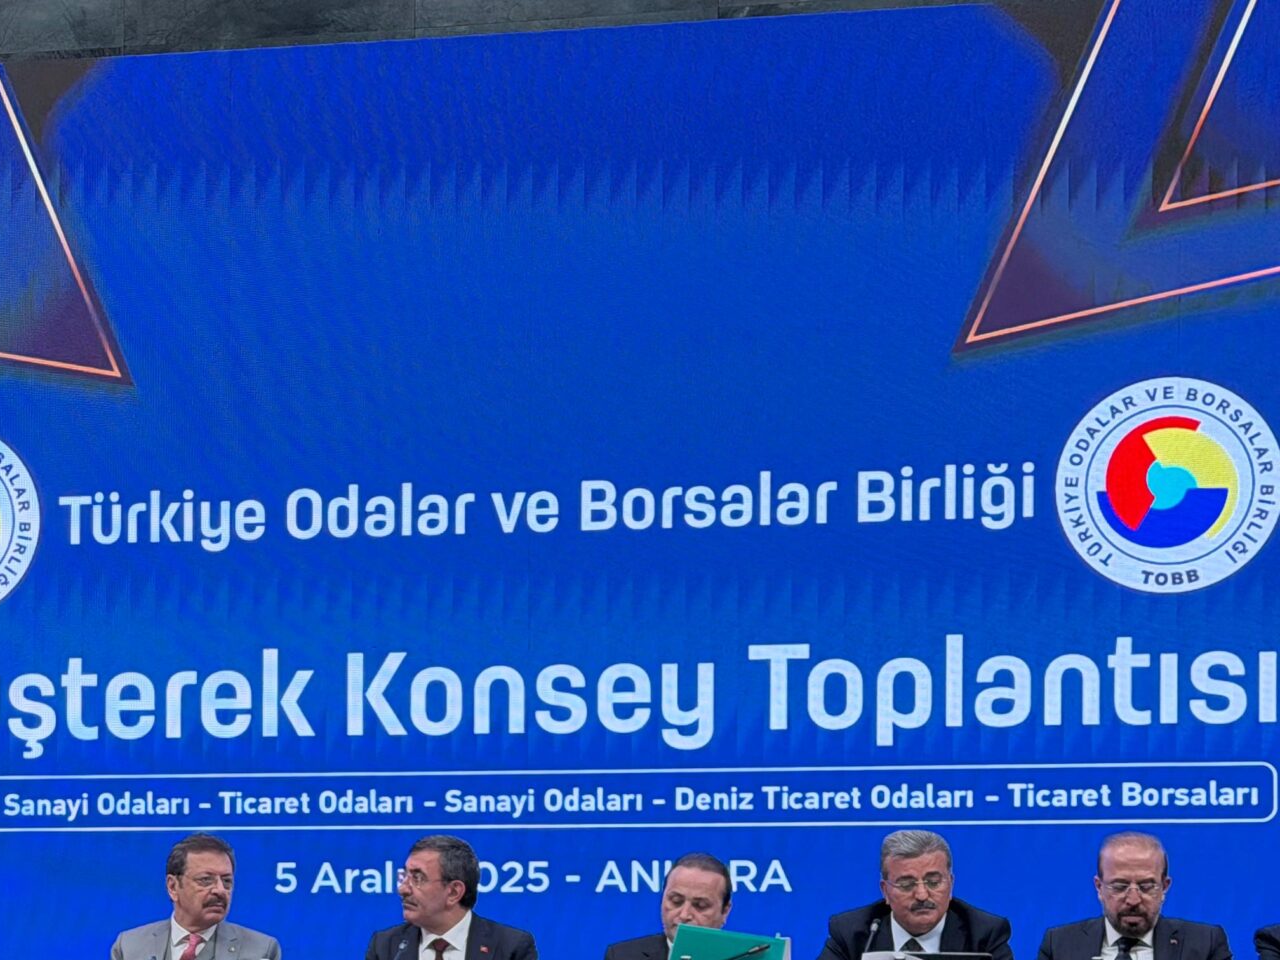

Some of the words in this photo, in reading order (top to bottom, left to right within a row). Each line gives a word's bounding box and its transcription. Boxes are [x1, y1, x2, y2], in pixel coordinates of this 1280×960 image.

[1069, 395, 1138, 466] ODALAR
[1145, 386, 1175, 401] VE
[1186, 387, 1273, 474] BORSALAR
[59, 489, 265, 552] Türkiye
[287, 483, 475, 539] Odalar
[491, 491, 558, 533] ve
[581, 471, 837, 531] Borsalar
[858, 462, 1034, 529] Birliği
[1141, 569, 1200, 586] TOBB
[347, 652, 714, 750] Konsey
[748, 634, 1277, 746] Toplantısı
[4, 793, 88, 821] Sanayi
[98, 791, 189, 815] Odaları
[219, 792, 310, 814] Ticaret
[319, 789, 413, 813] Odaları
[445, 789, 534, 818] Sanayi
[544, 787, 642, 811] Odaları
[676, 787, 753, 810] Deniz
[762, 786, 861, 809] Ticaret
[875, 783, 973, 808] Odaları
[1008, 784, 1111, 807] Ticaret
[1122, 780, 1258, 806] Borsaları
[275, 862, 297, 893] 5
[478, 861, 549, 892] 025
[596, 860, 792, 892] ANRA
